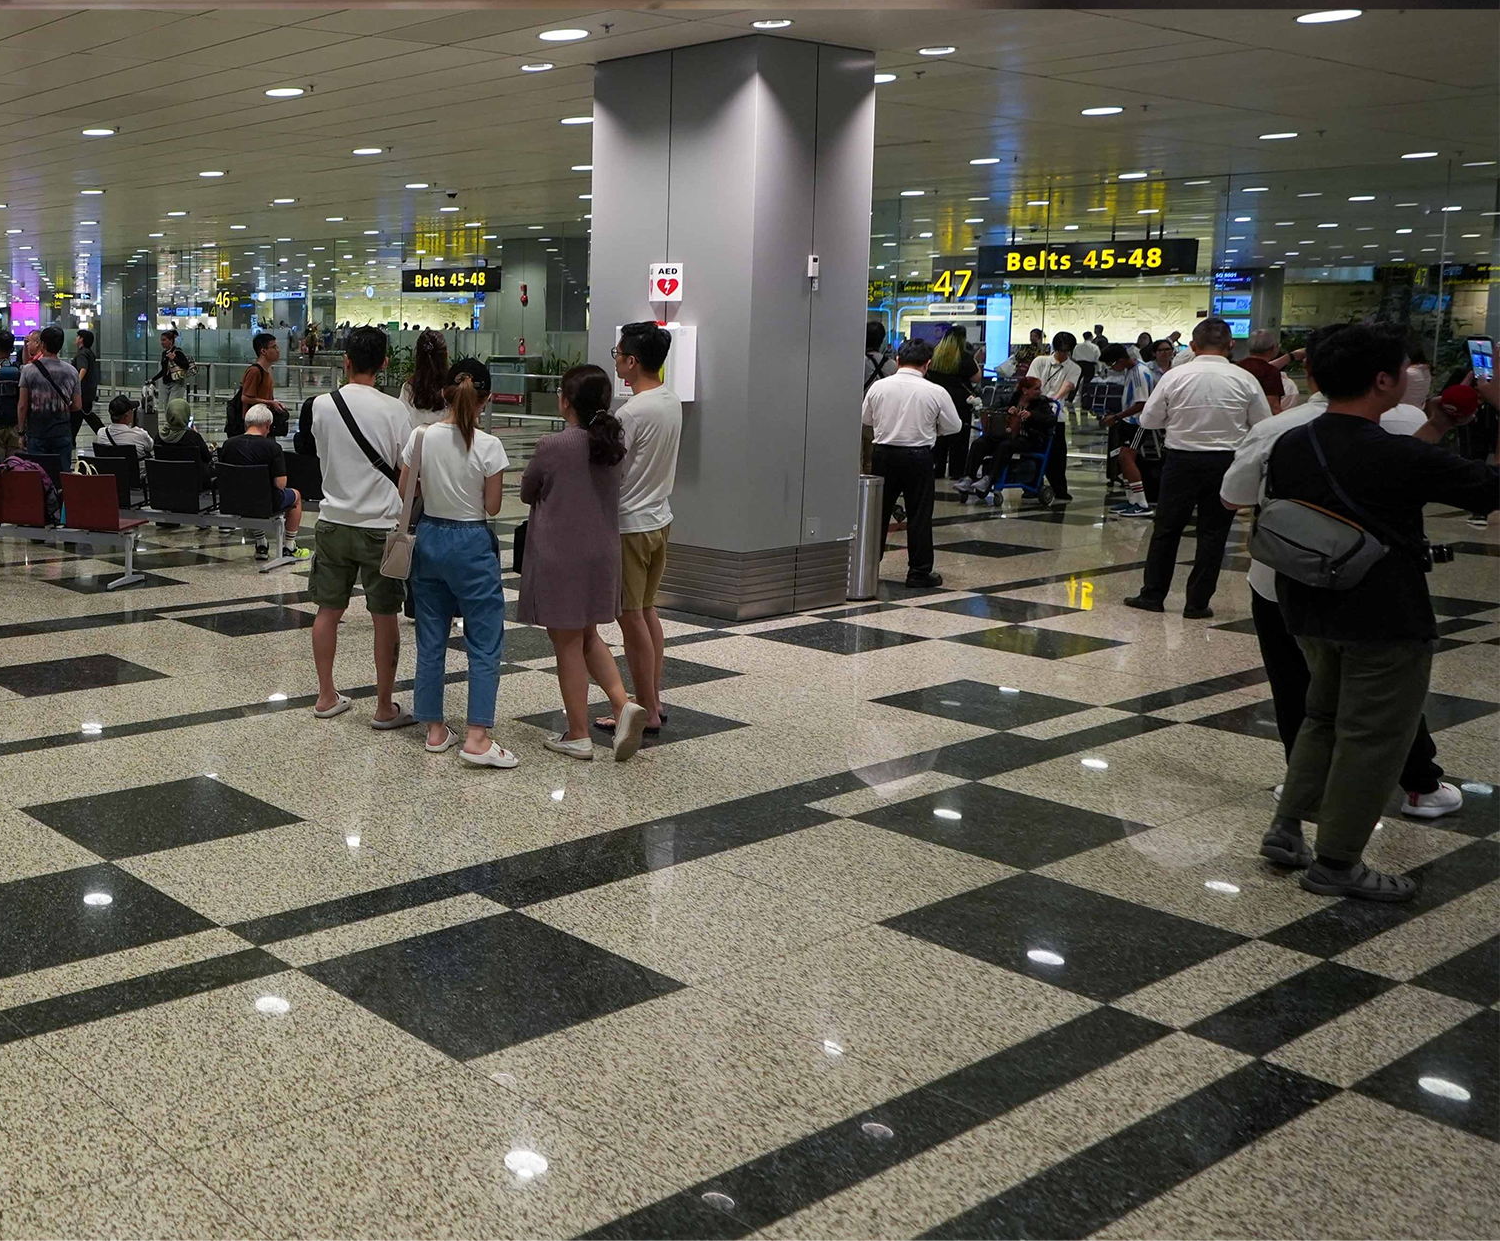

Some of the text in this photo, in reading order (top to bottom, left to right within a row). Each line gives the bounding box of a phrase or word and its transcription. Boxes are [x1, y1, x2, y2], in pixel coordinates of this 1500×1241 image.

[1006, 248, 1162, 272] Belts 45-48
[415, 272, 486, 287] Belts 45-48
[933, 270, 972, 298] 47
[215, 291, 230, 308] 46
